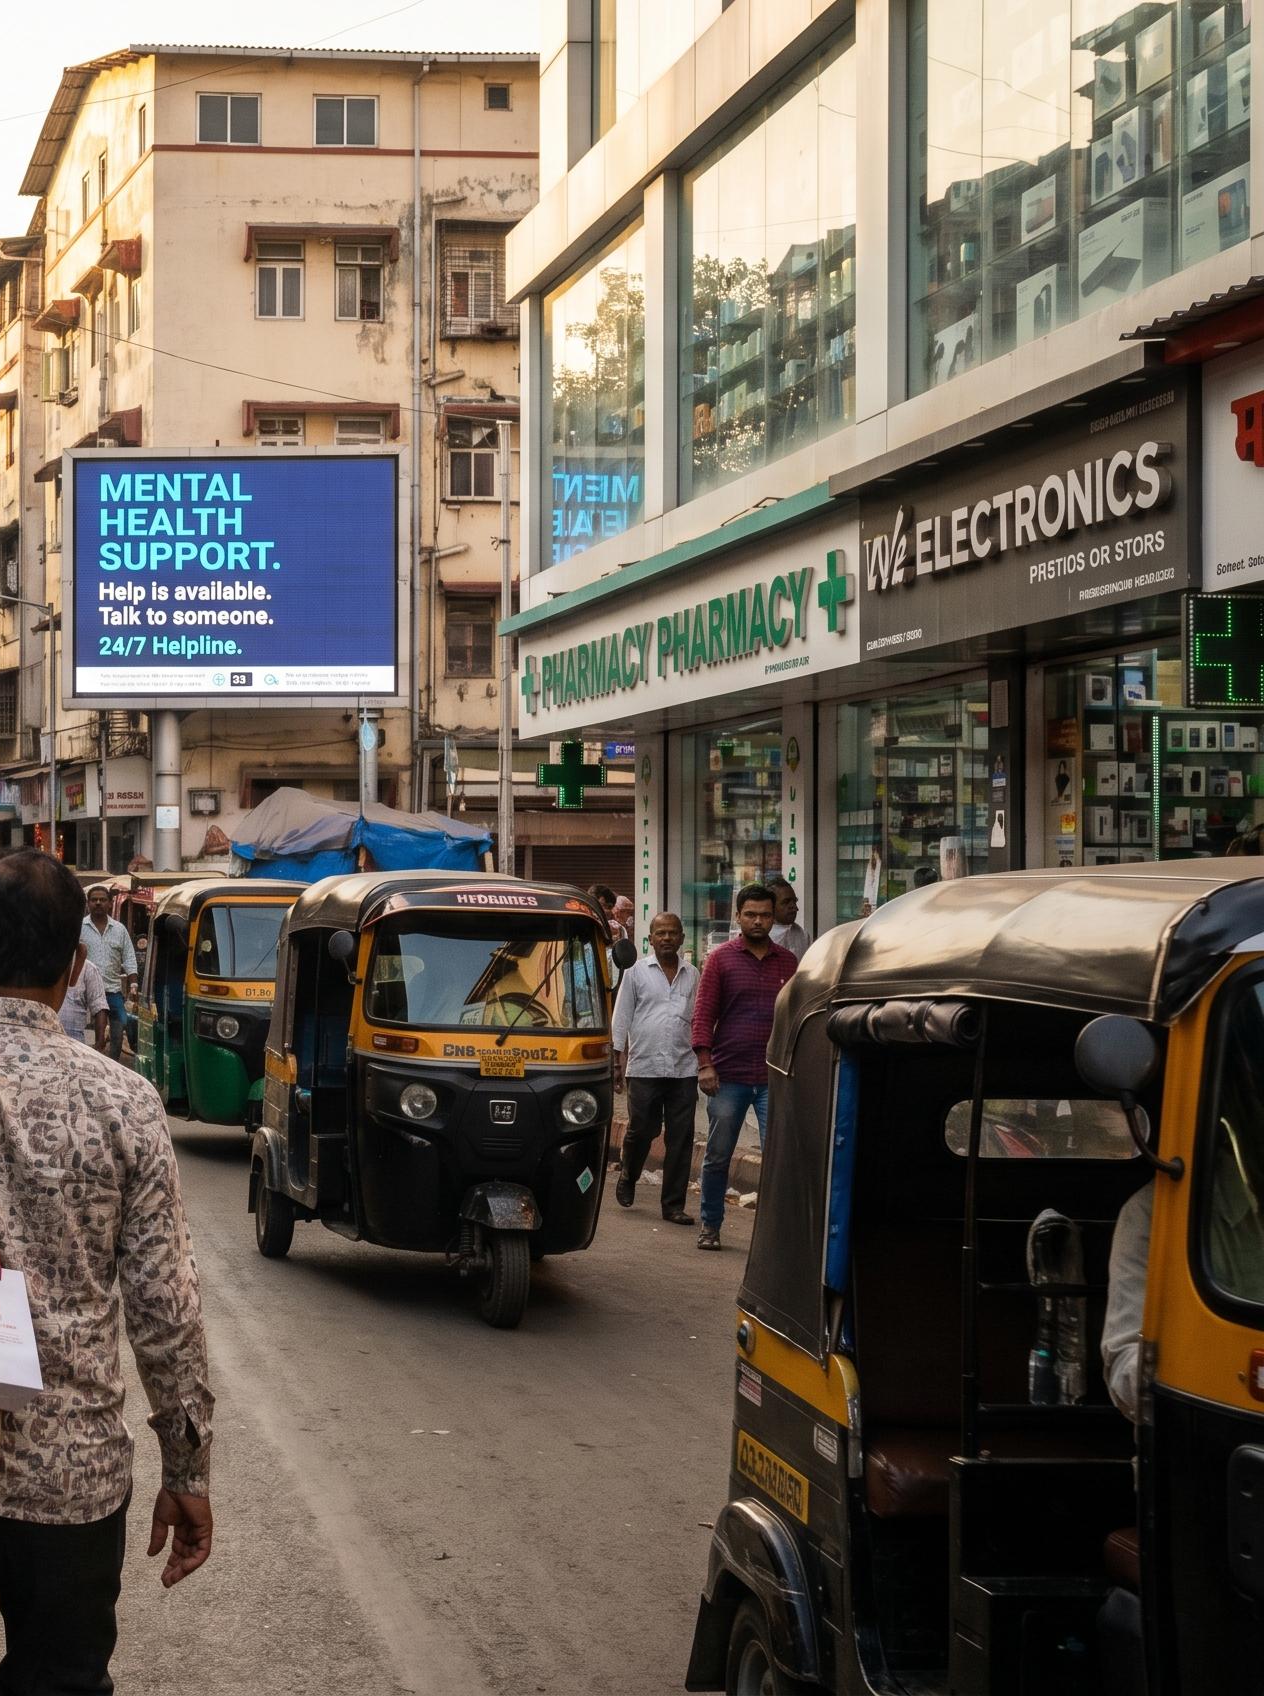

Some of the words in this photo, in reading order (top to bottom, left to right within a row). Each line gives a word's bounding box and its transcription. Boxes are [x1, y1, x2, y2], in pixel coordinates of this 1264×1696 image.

[100, 473, 253, 502] MENTAL
[100, 507, 243, 536] HEALTH
[916, 441, 1161, 577] ELECTRONICS
[99, 541, 281, 571] SUPPORT.
[1089, 544, 1111, 568] OR
[1114, 530, 1166, 562] STORS
[99, 581, 146, 604] Help
[152, 581, 169, 601] is
[174, 580, 273, 601] available.
[99, 606, 141, 626] Talk
[146, 607, 168, 626] to
[172, 608, 275, 626] someone.
[99, 636, 146, 657] 24/7
[152, 635, 243, 660] Helpline.
[541, 621, 653, 712] PHARMACY
[657, 566, 813, 680] PHARMACY
